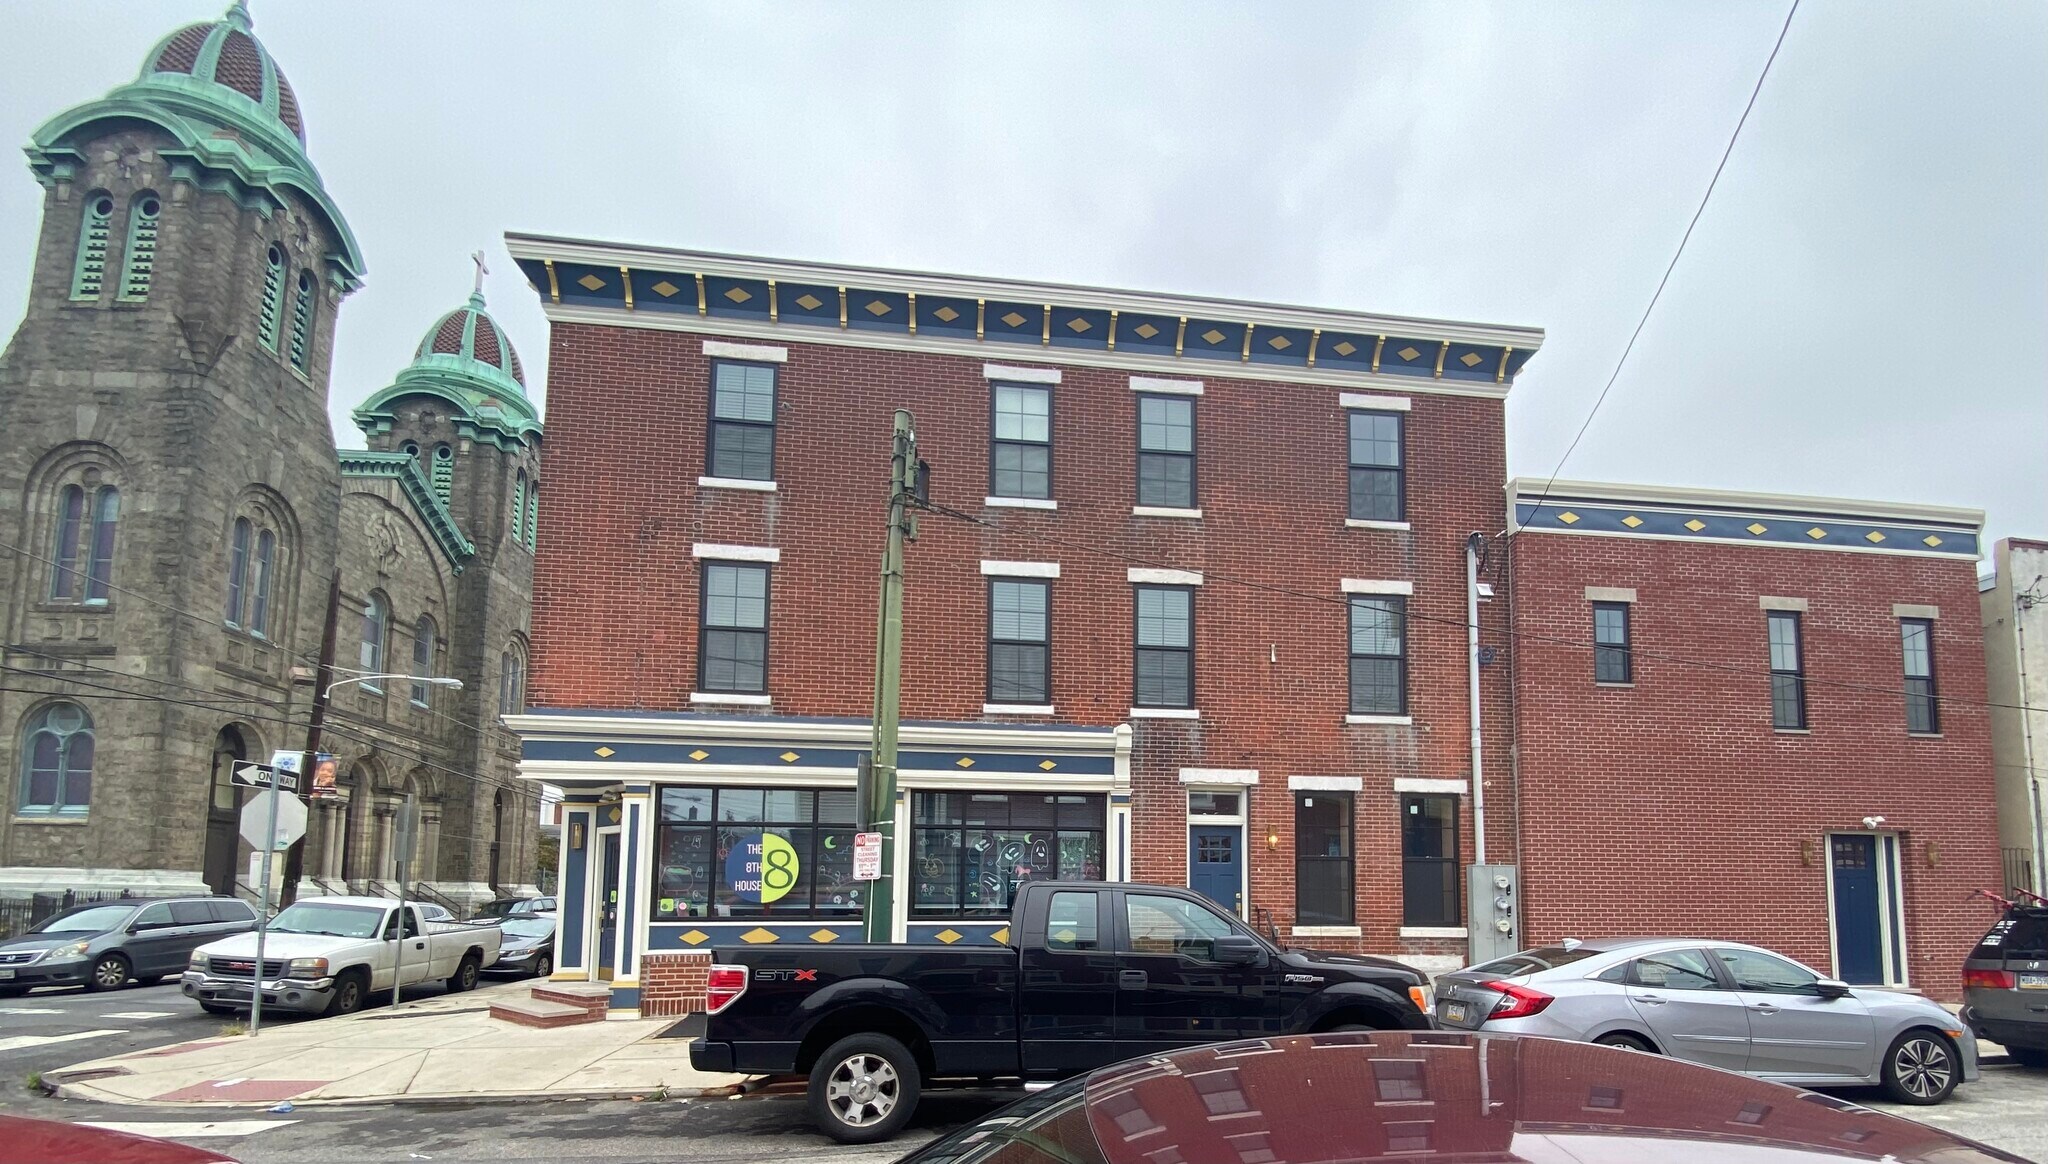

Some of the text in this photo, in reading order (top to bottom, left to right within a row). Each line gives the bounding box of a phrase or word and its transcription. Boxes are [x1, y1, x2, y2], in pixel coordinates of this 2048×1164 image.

[258, 771, 295, 788] ON WAY
[856, 835, 865, 846] NO
[747, 844, 763, 854] THE
[746, 862, 763, 872] 8TH
[764, 849, 793, 889] 8
[735, 881, 762, 891] HOUSE
[755, 969, 817, 980] STX
